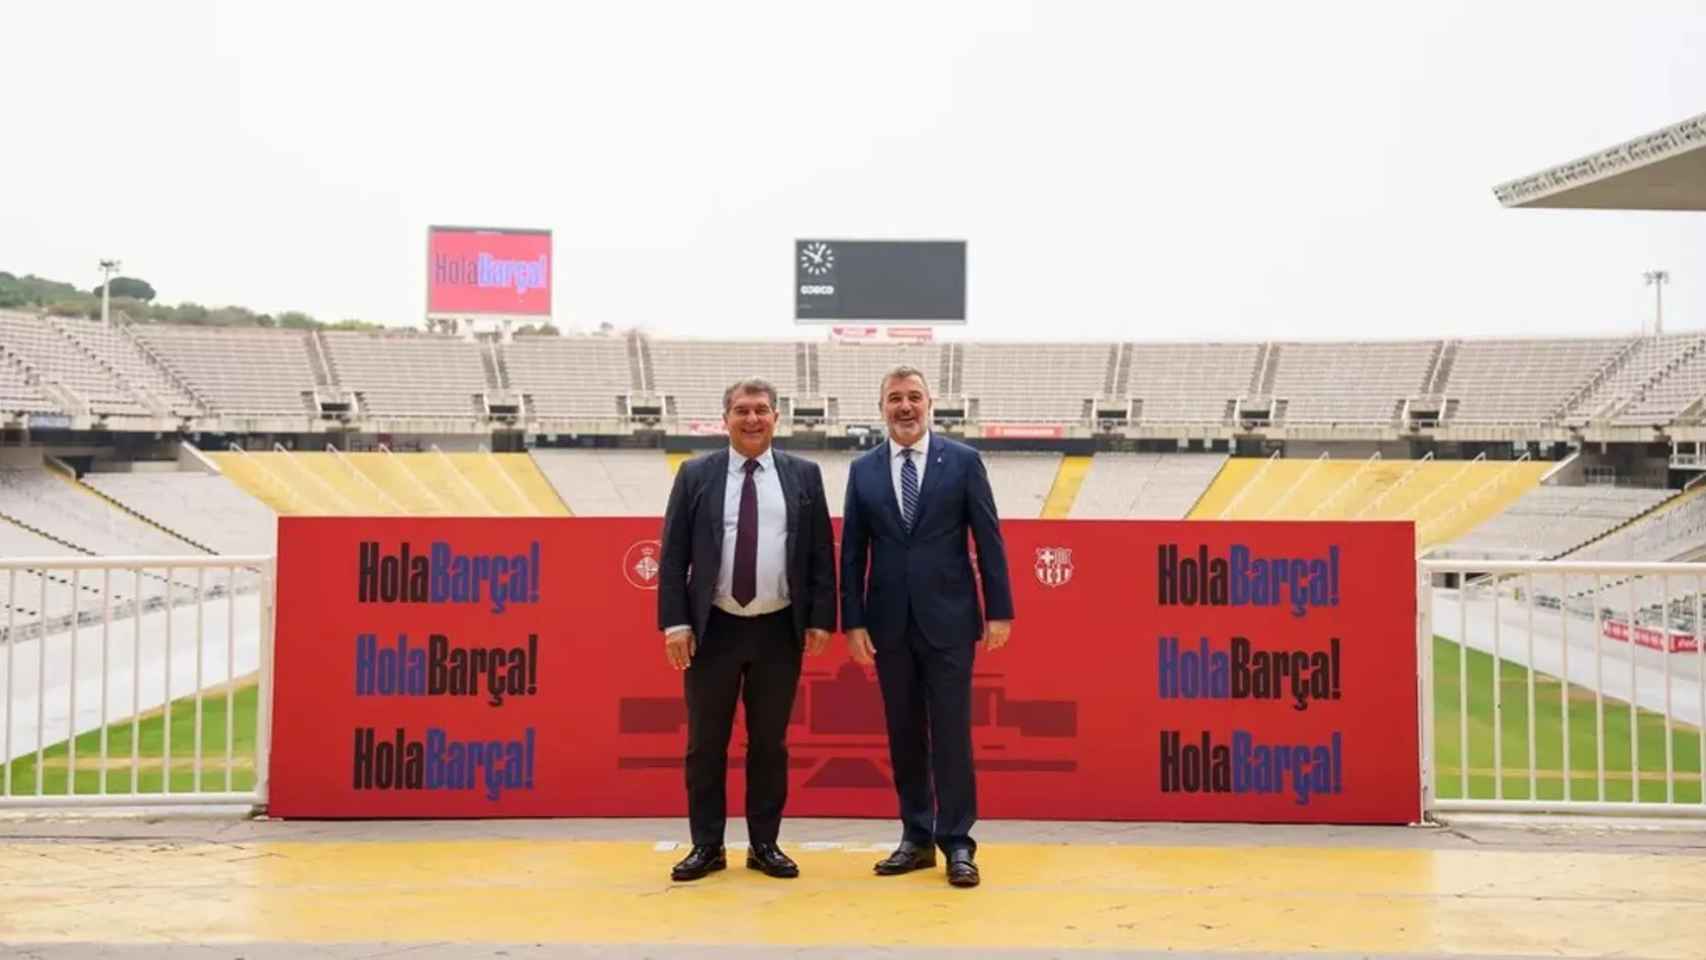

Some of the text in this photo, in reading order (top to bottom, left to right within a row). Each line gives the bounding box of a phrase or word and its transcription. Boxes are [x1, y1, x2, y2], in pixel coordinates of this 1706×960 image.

[358, 541, 540, 613] HolaBarça!
[1158, 544, 1339, 617] HolaBarça!
[356, 634, 538, 707] HolaBarça!
[1158, 636, 1341, 711] HolaBarça!
[353, 727, 536, 801] HolaBarça!
[1160, 729, 1343, 806] HolaBarça!
